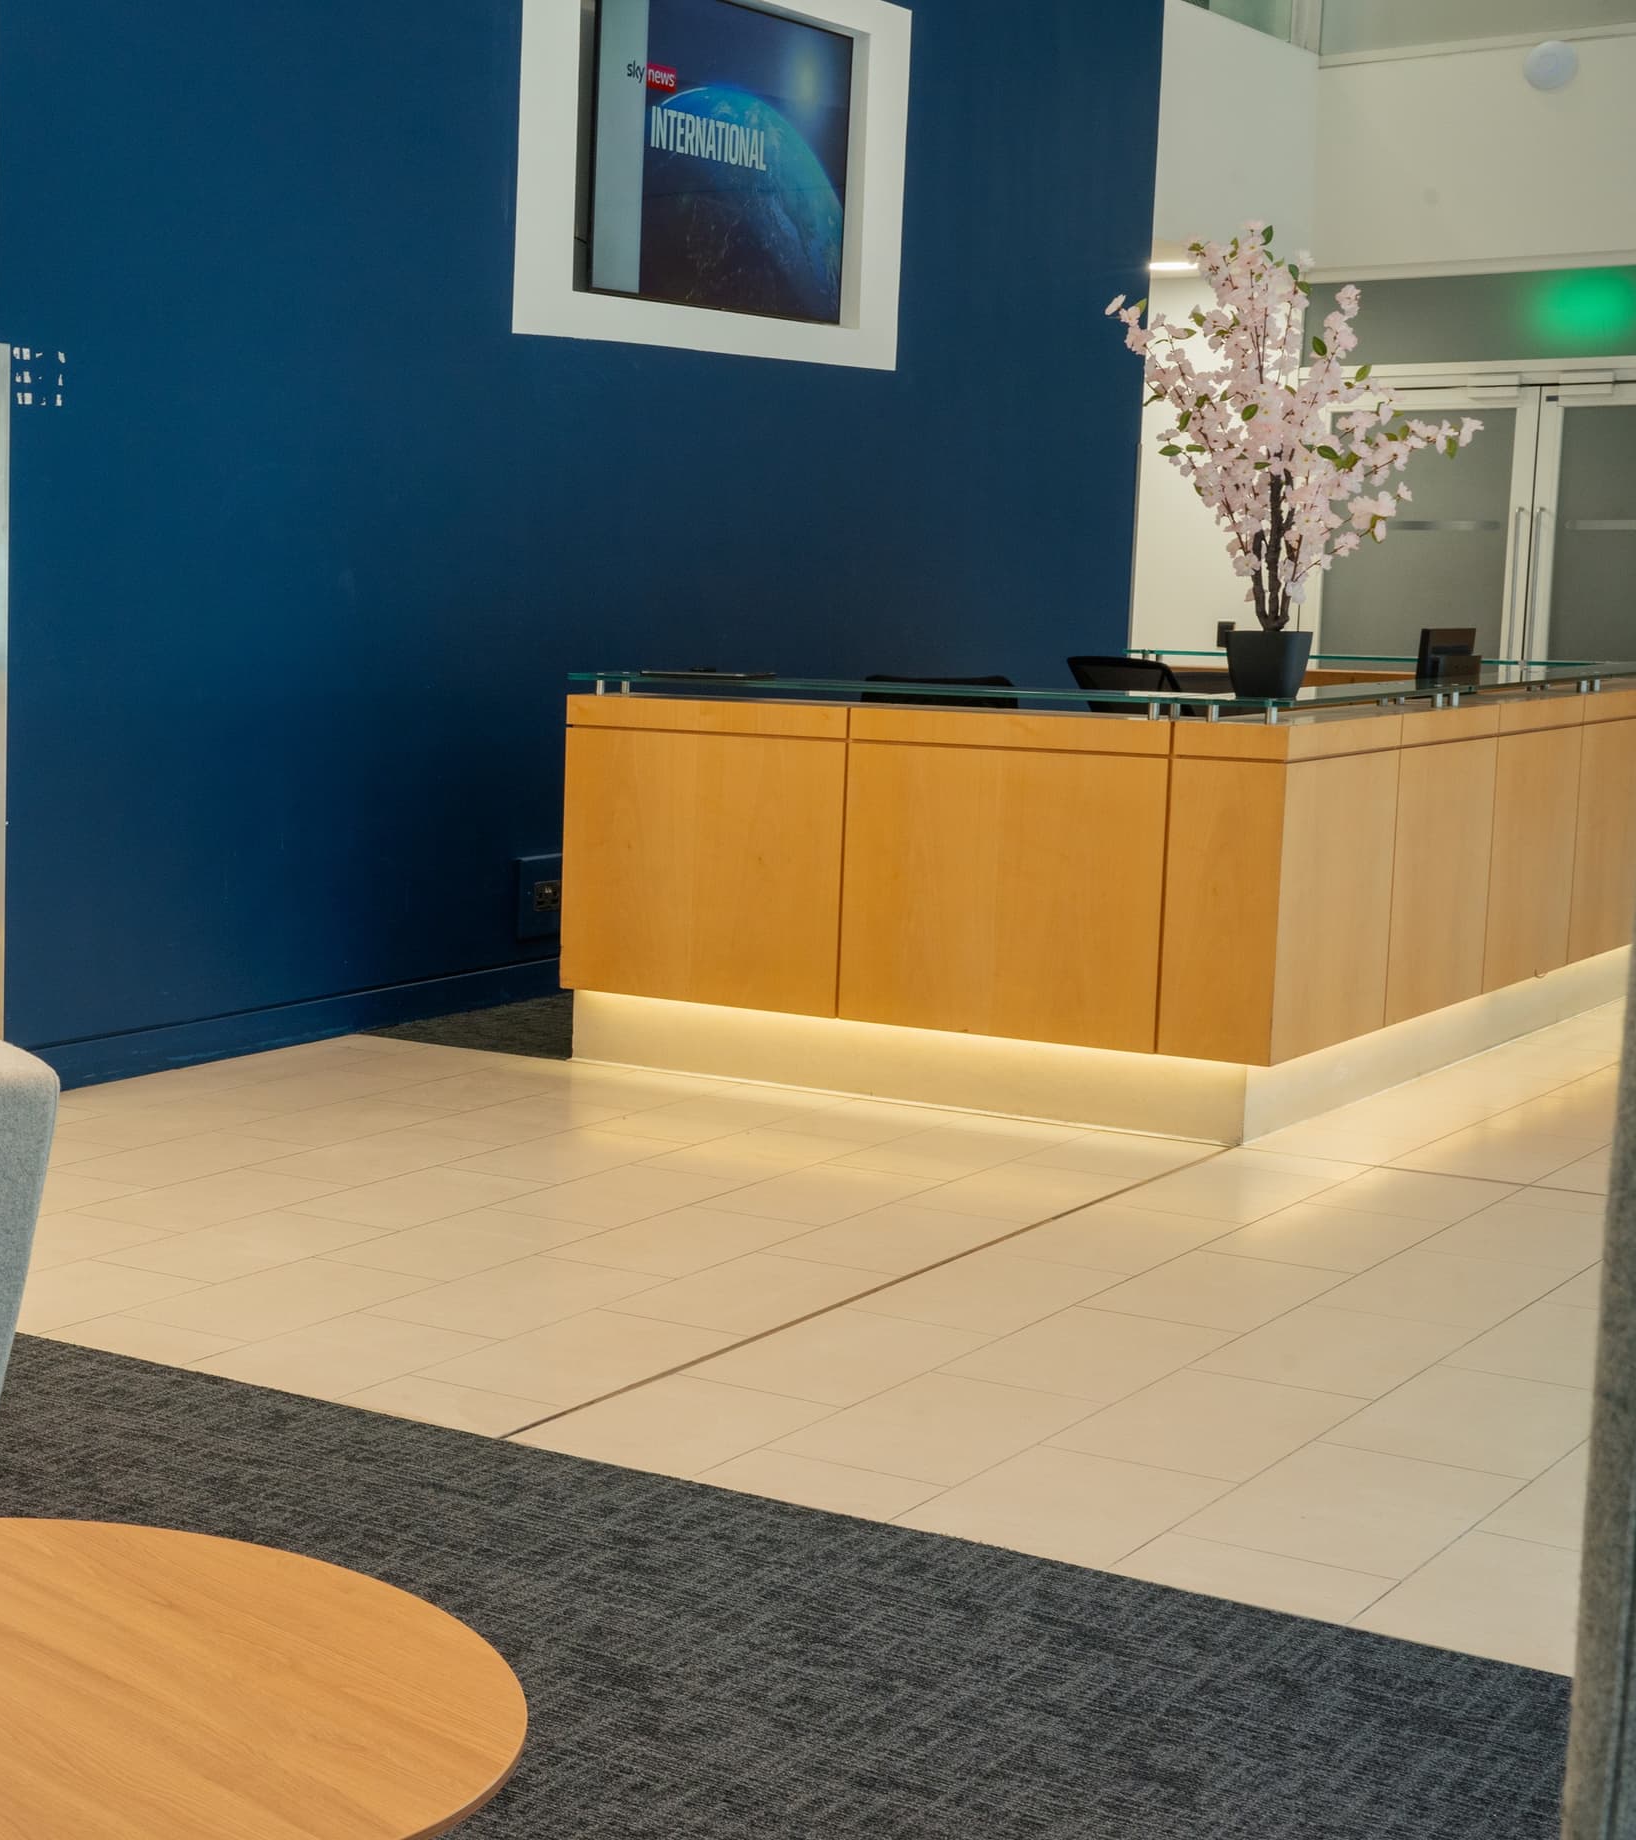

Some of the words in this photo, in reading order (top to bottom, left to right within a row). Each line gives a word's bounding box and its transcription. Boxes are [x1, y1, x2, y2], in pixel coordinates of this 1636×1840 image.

[627, 61, 645, 82] sky
[648, 68, 675, 87] news
[651, 106, 766, 170] INTERNATIONAL
